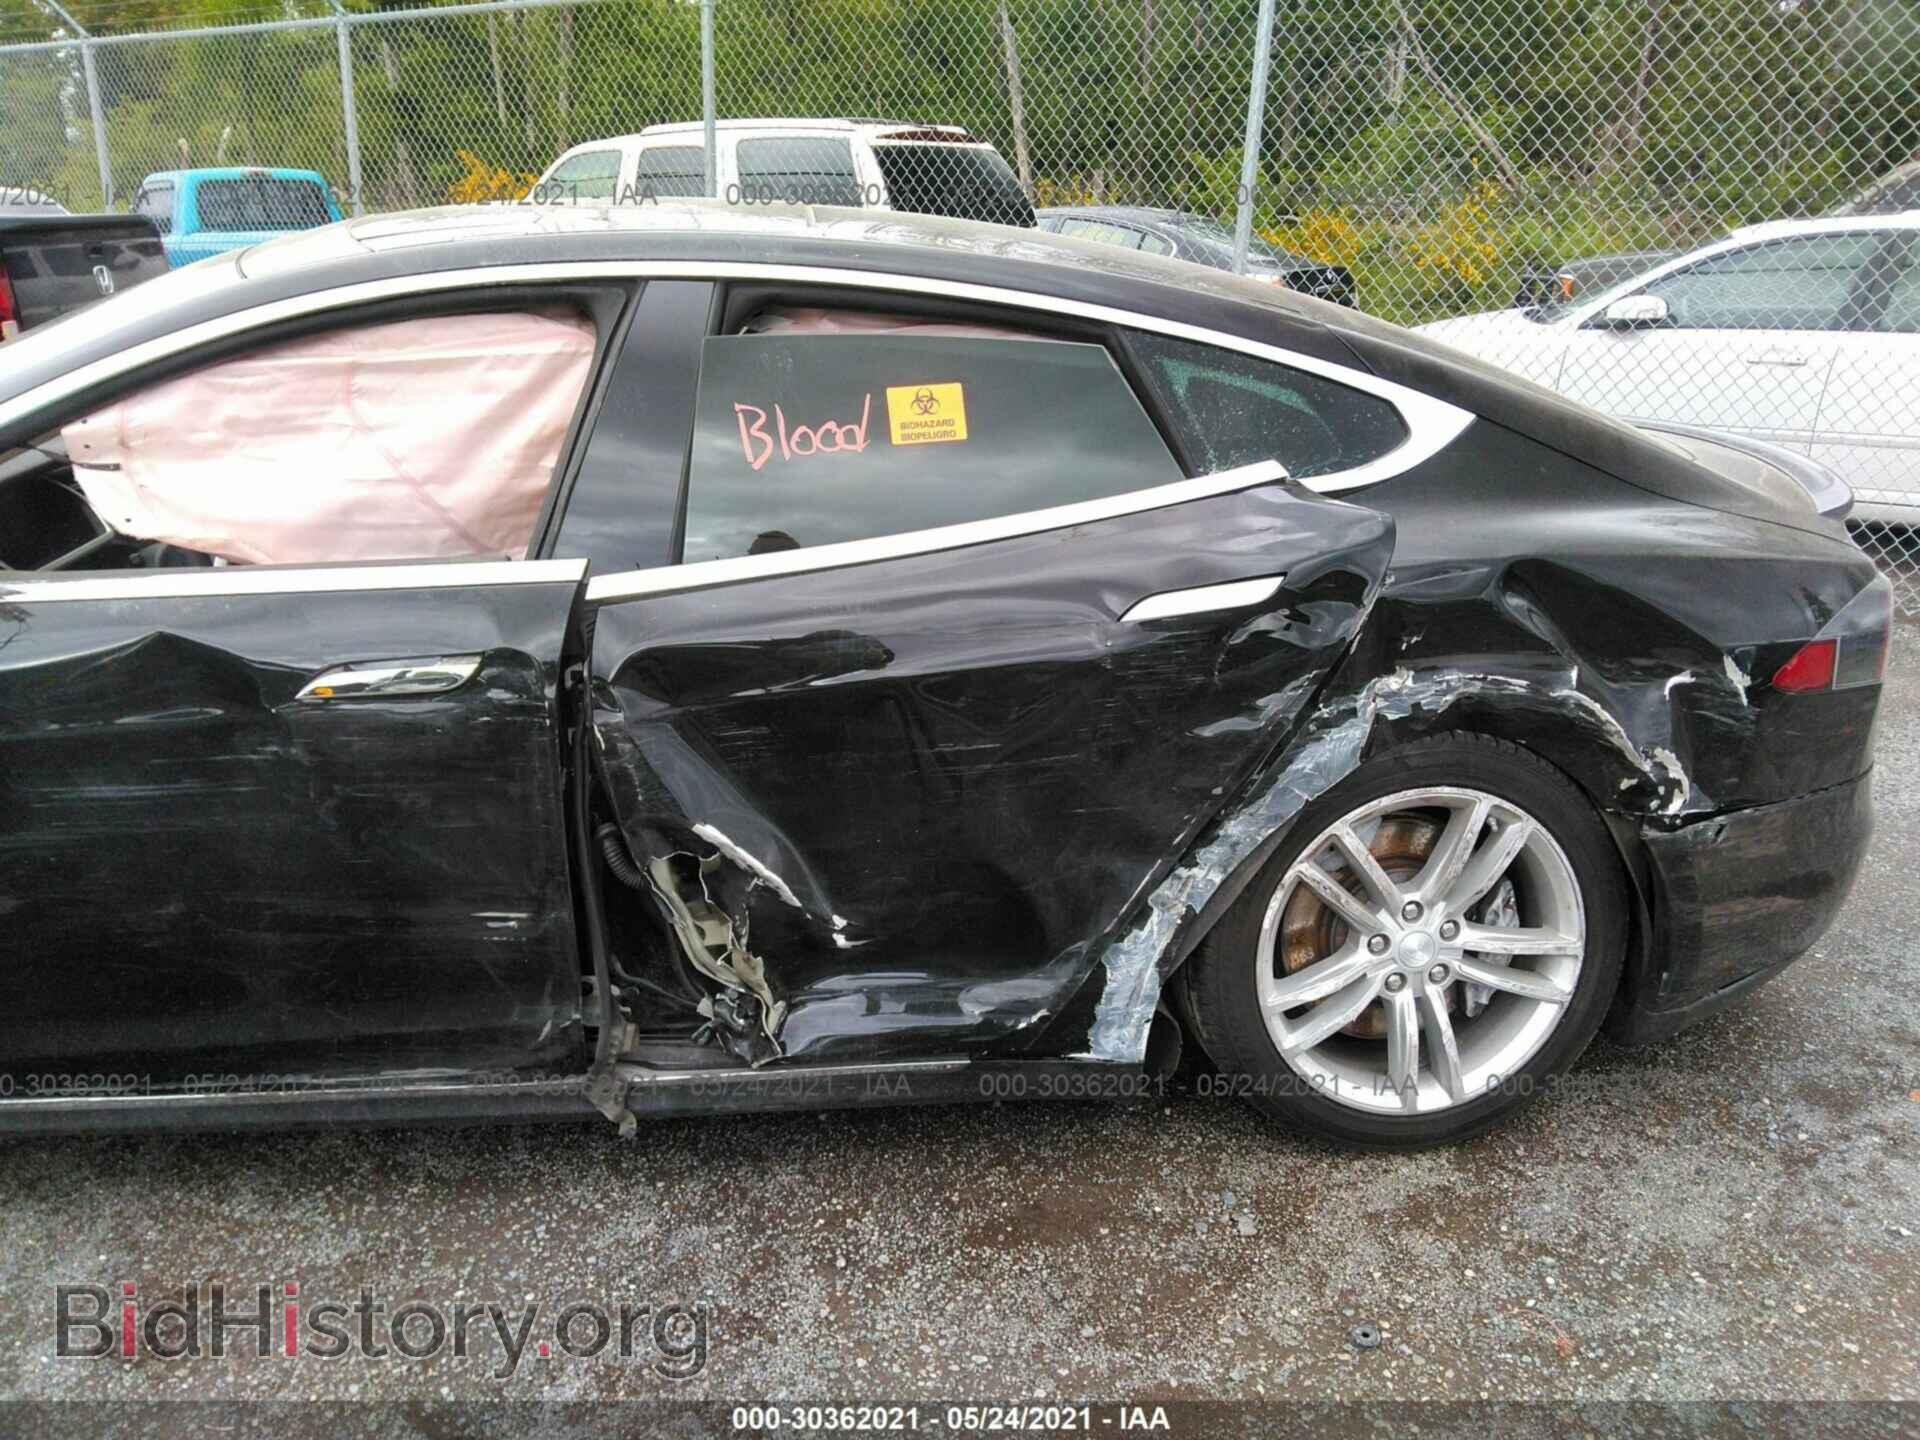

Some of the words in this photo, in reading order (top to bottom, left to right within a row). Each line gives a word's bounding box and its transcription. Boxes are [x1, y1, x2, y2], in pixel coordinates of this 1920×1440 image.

[734, 392, 871, 470] Blood
[900, 418, 955, 431] BIOHAZARD
[900, 429, 957, 441] BIOPELIGRO
